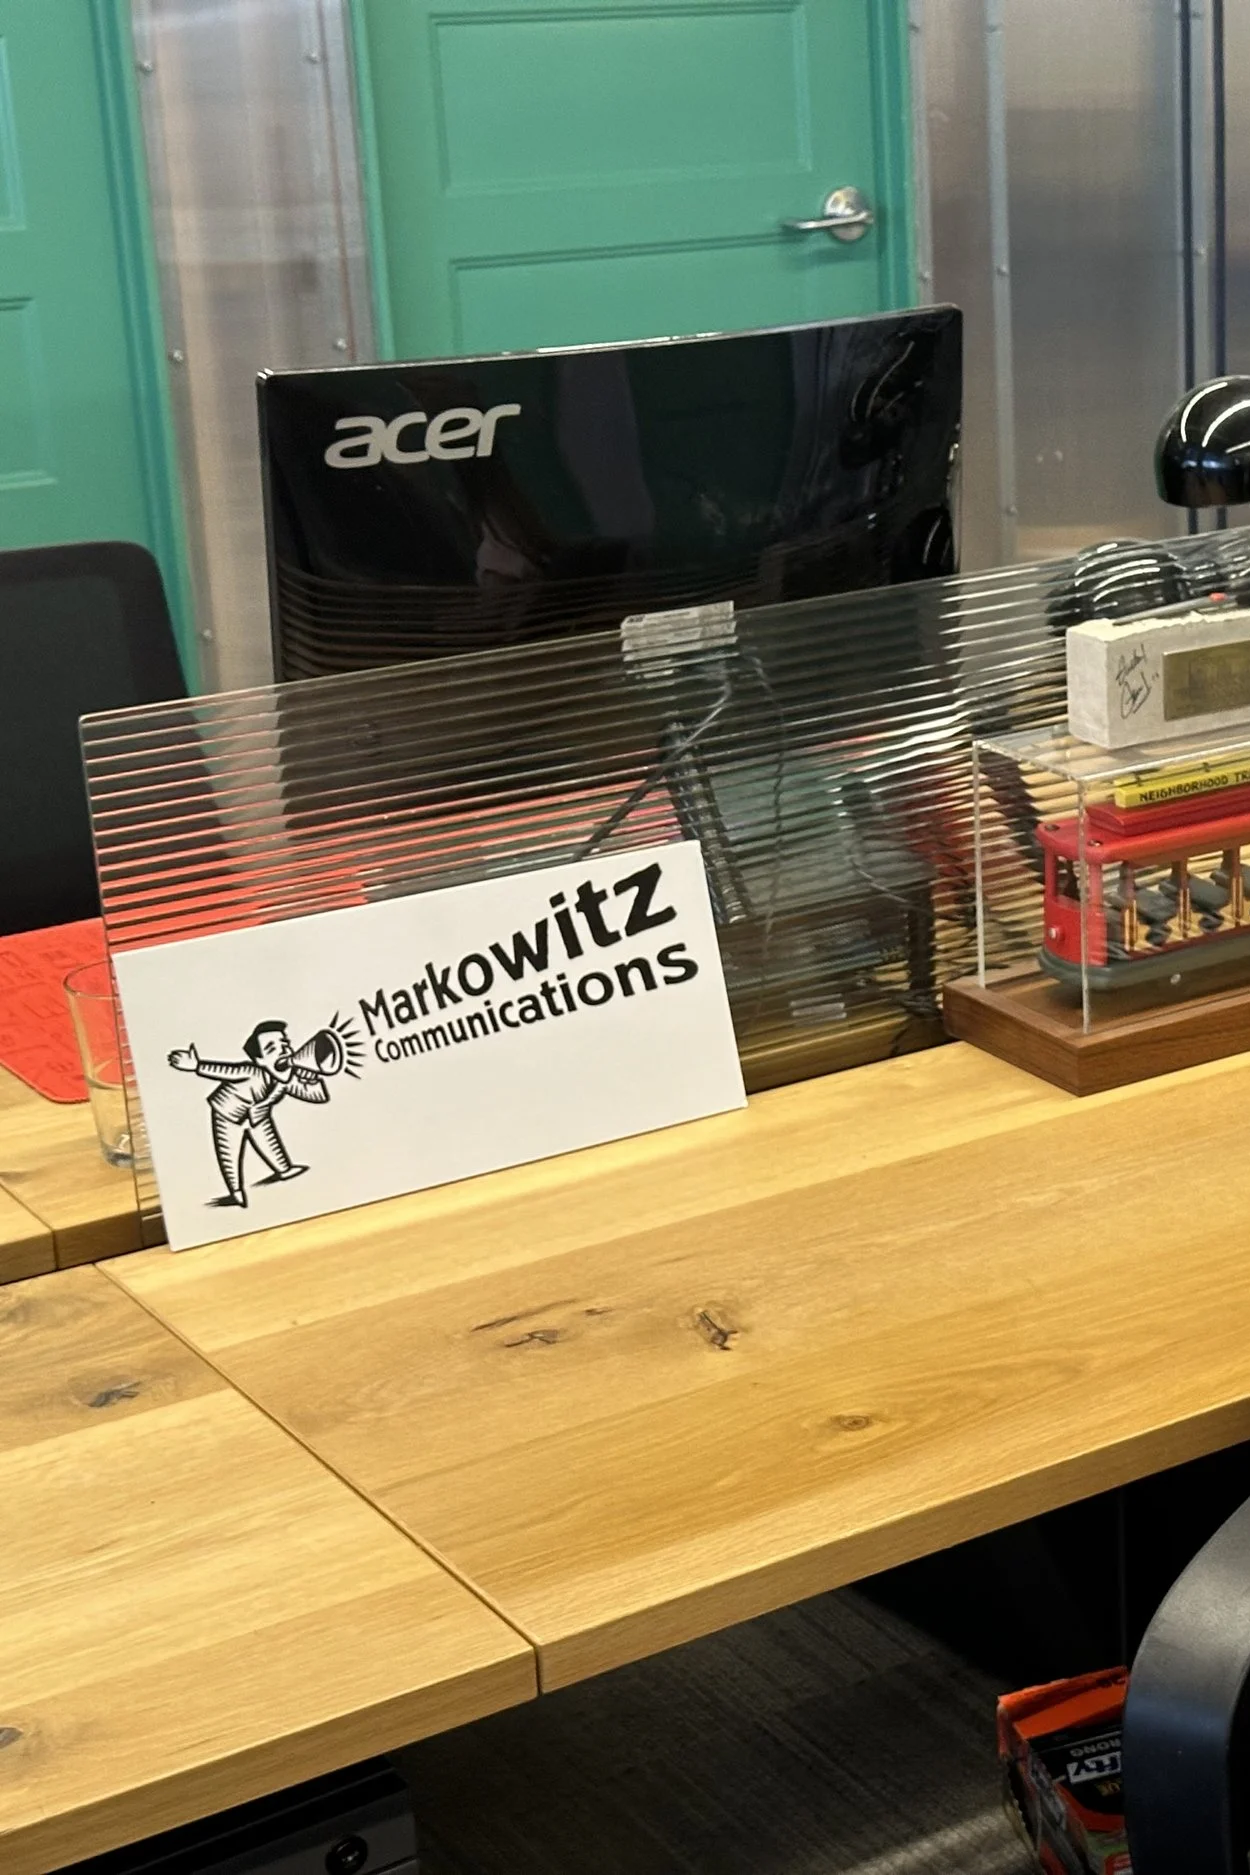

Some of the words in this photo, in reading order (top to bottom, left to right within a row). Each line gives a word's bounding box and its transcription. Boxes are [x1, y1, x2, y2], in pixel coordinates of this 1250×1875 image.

[324, 403, 521, 468] acer
[1139, 775, 1229, 803] NEIGHBORHOOD
[358, 861, 676, 1037] Markowitz
[374, 941, 699, 1062] Communications
